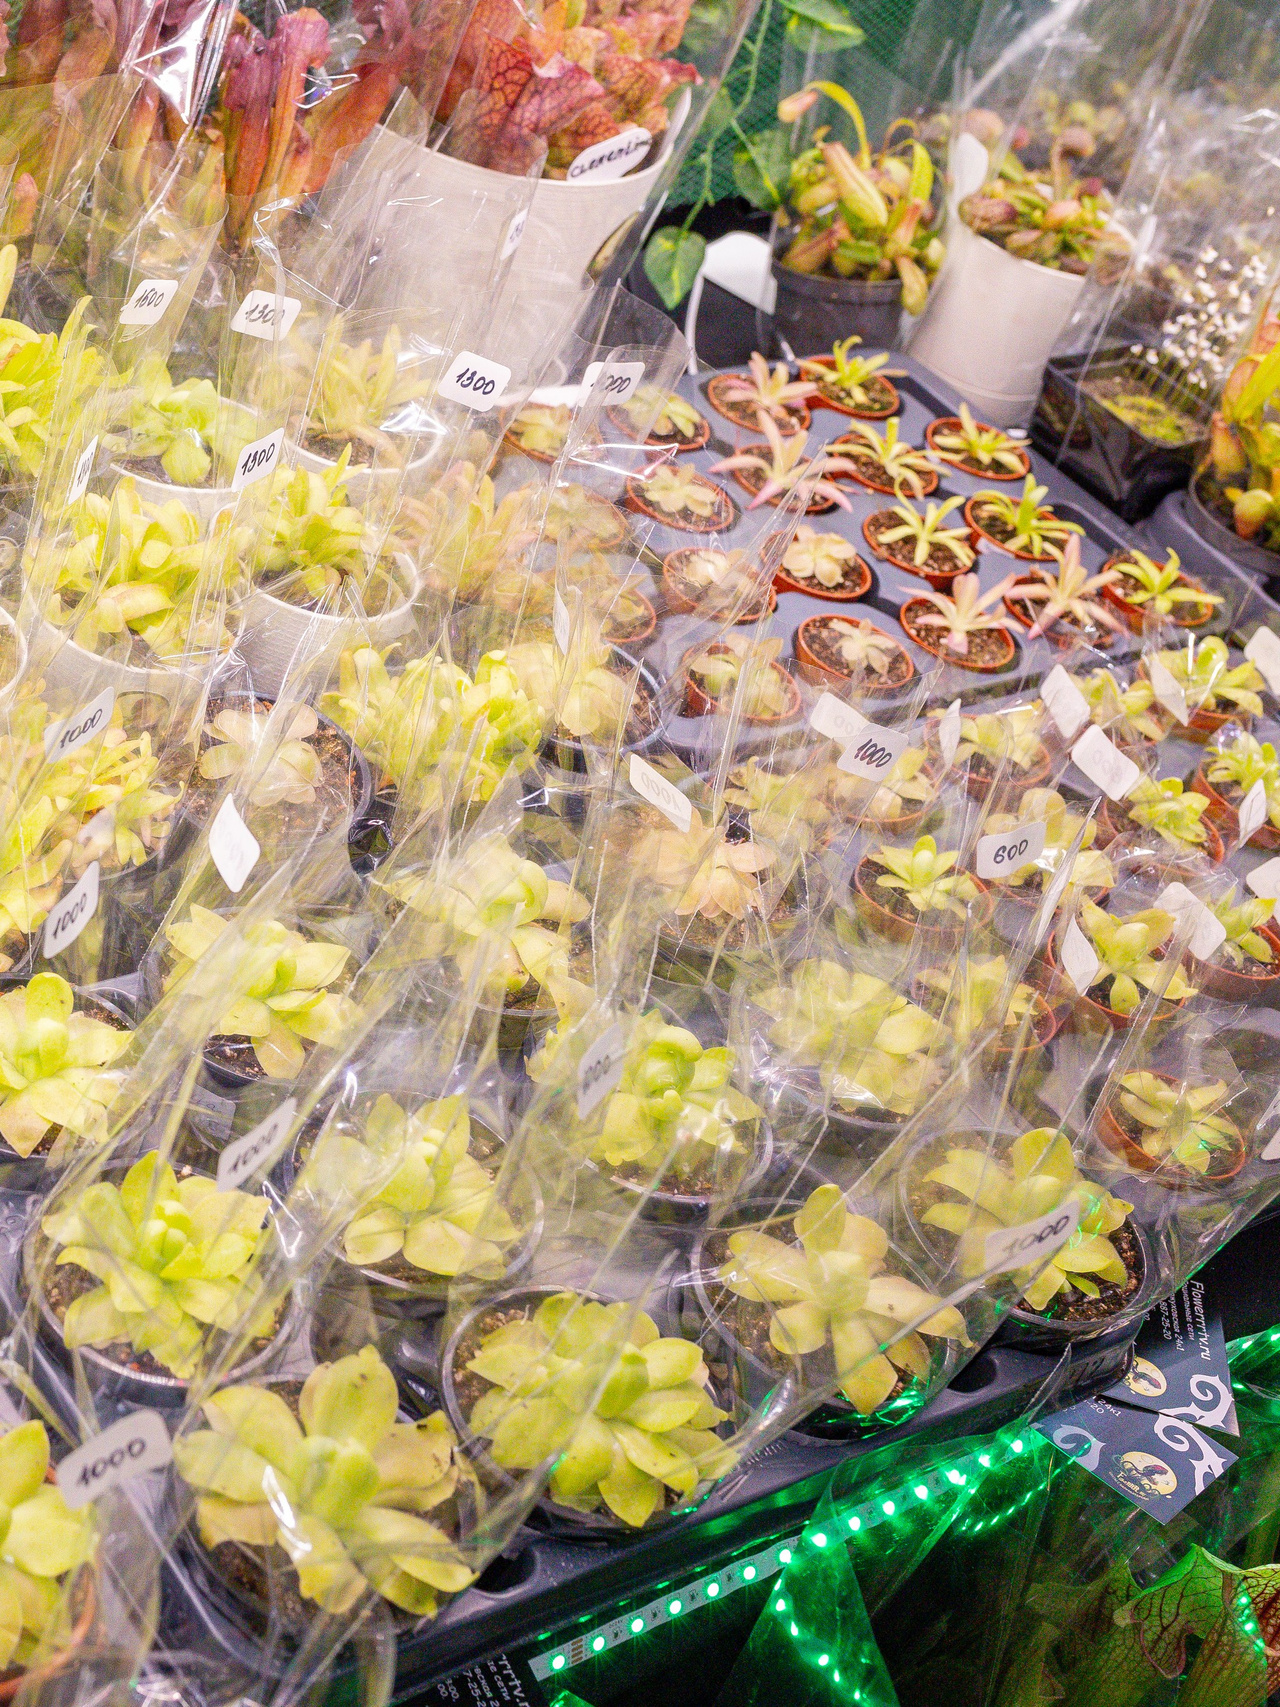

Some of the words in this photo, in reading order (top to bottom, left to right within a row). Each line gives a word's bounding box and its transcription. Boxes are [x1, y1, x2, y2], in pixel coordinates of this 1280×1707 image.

[455, 367, 496, 396] 1300
[241, 442, 276, 476] 1300
[59, 708, 104, 749] 1000
[852, 738, 893, 768] 1000
[992, 838, 1029, 865] 600
[51, 892, 88, 940] 1000
[75, 1437, 147, 1487] 1000
